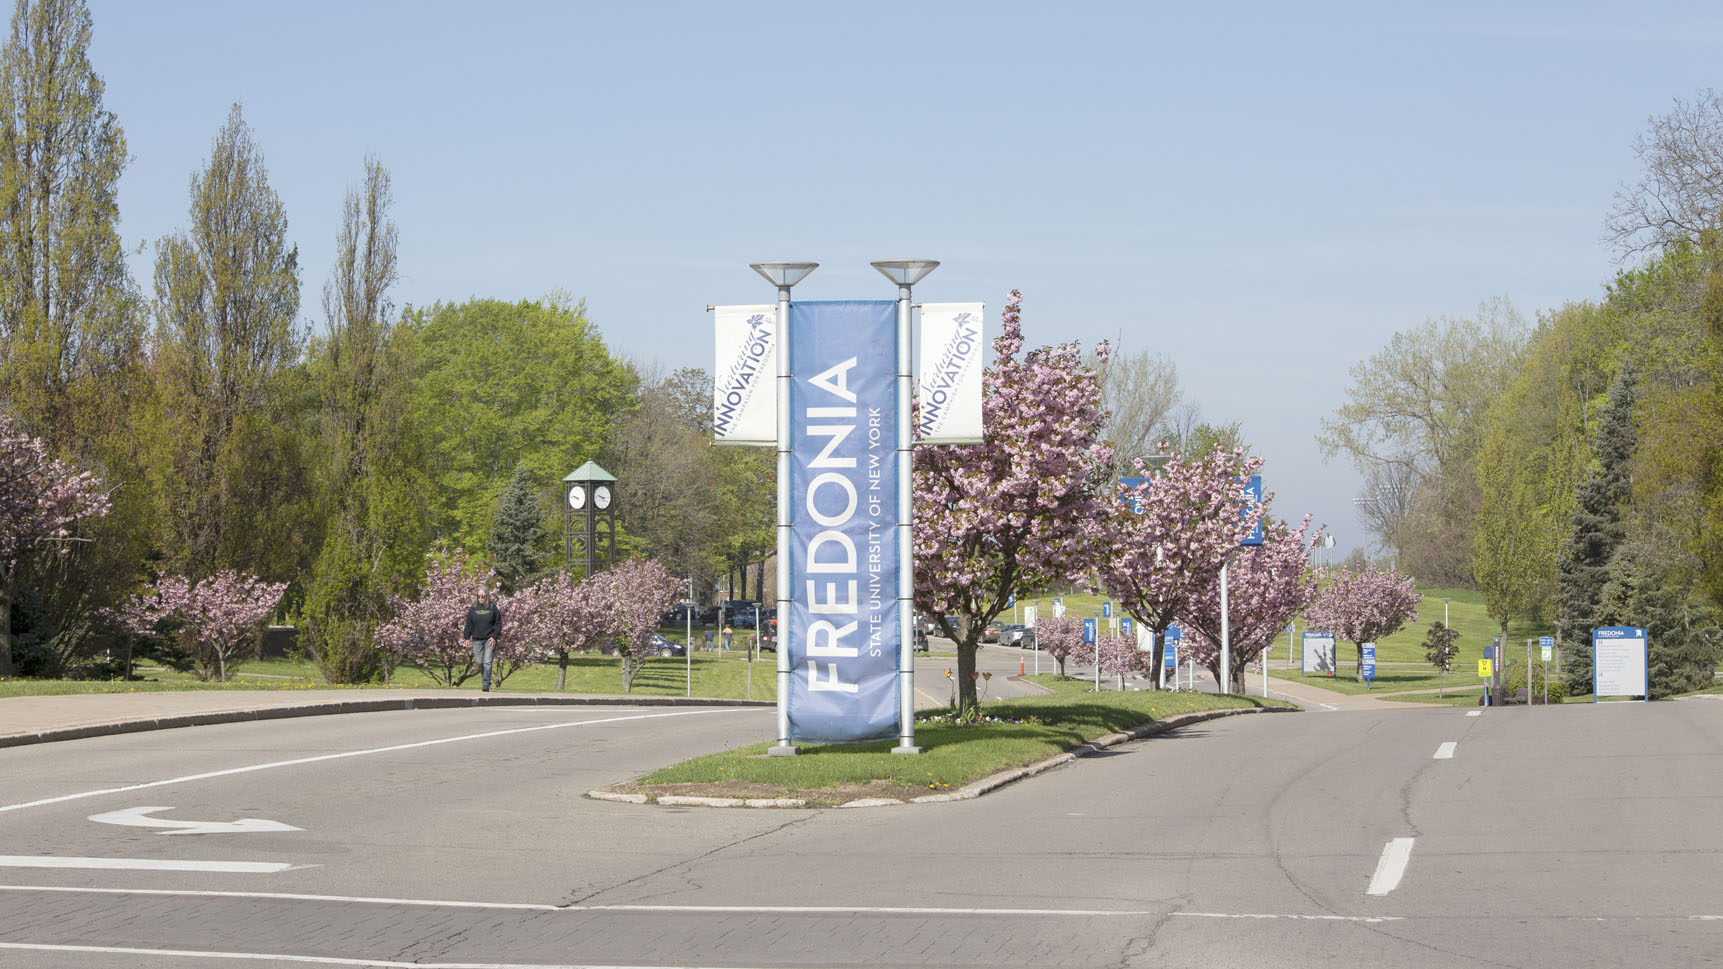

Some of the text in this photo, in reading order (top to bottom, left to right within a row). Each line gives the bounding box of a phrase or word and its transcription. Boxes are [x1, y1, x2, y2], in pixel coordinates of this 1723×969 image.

[714, 329, 772, 437] INNOVATION
[920, 328, 978, 437] INNOVATION
[807, 356, 858, 693] FREDONIA
[868, 407, 882, 658] STATE UNIVERSITY OF NEW YORK
[1246, 487, 1255, 539] FONIA
